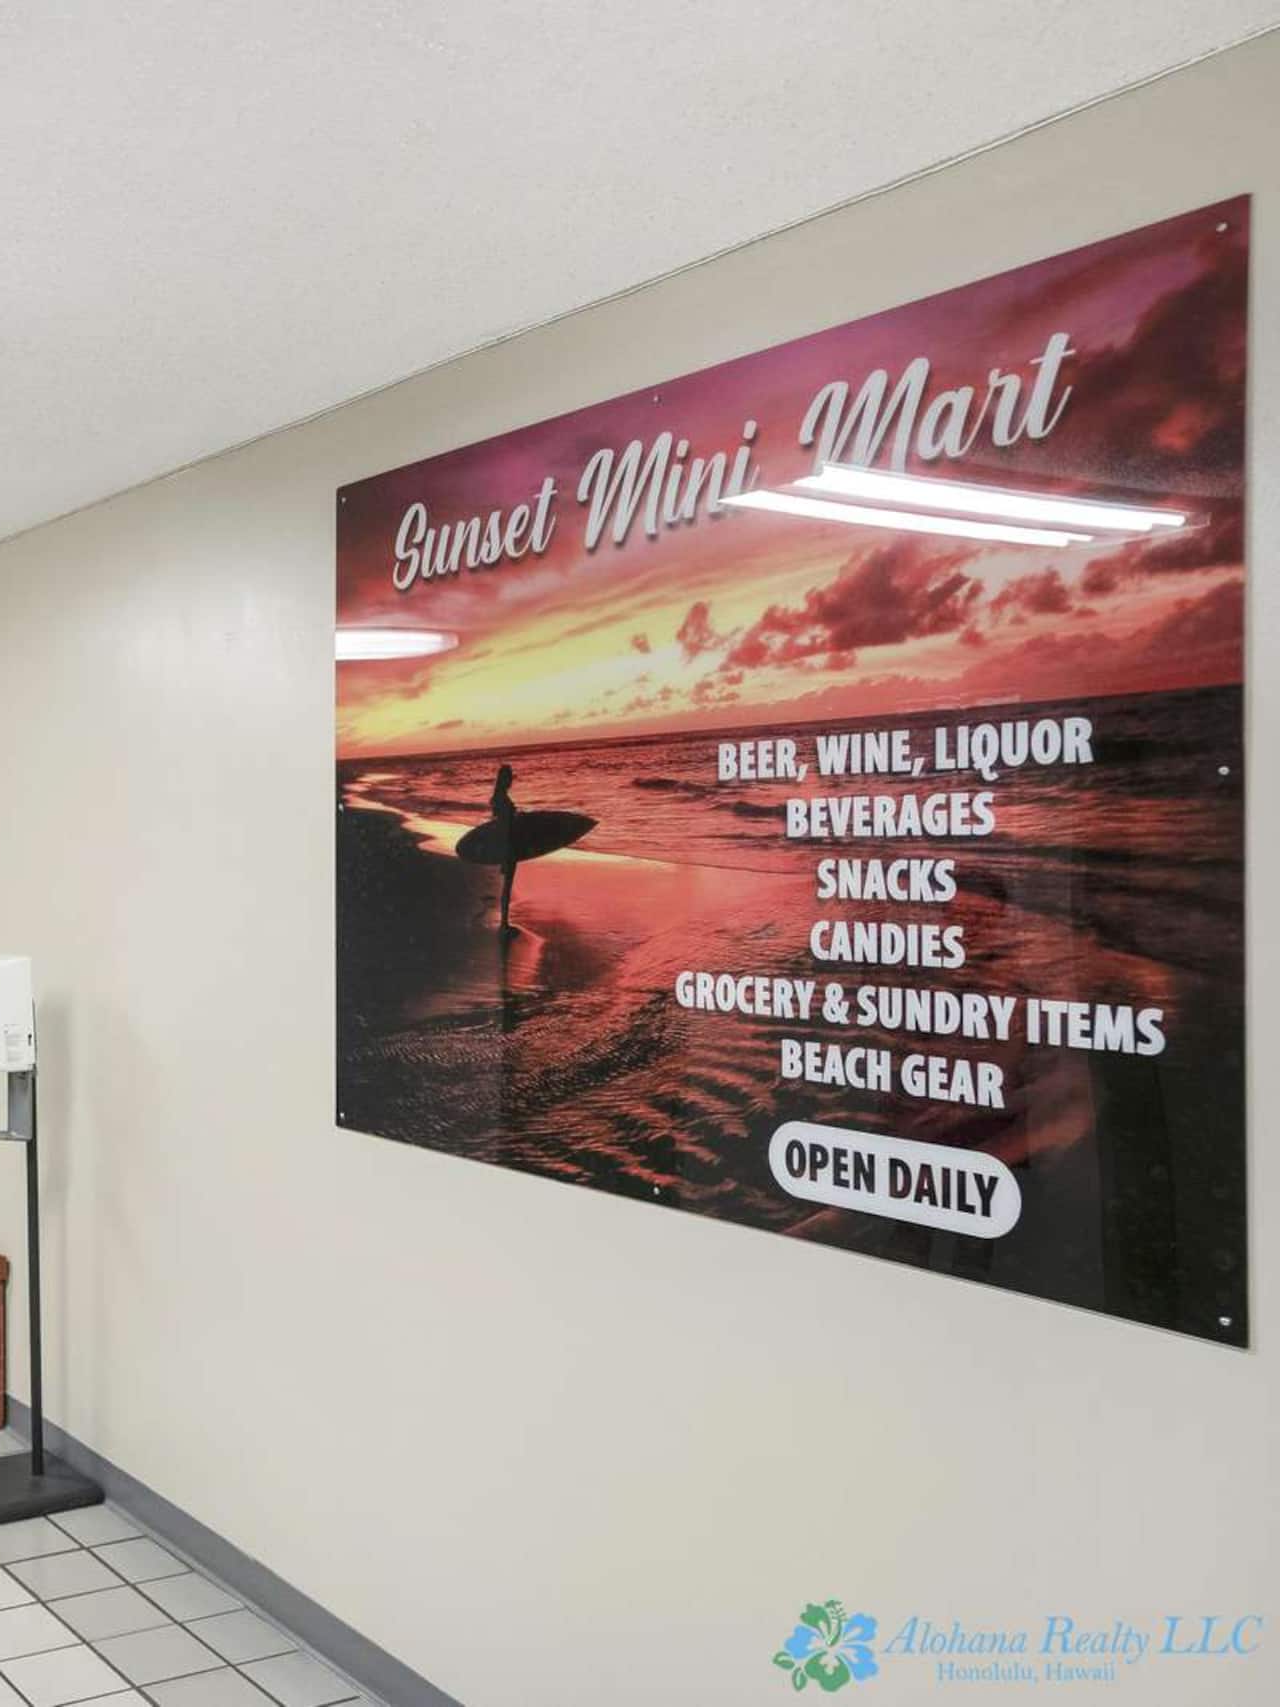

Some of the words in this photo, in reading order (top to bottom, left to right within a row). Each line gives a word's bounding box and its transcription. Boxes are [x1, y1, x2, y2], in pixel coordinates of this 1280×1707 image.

[393, 477, 558, 592] Sunset
[577, 420, 760, 549] Mini
[799, 332, 1076, 476] Mart
[718, 739, 808, 782] BEER,
[816, 730, 925, 777] WINE,
[934, 717, 1094, 782] LIQUOR
[786, 792, 997, 839] BEVERAGES
[817, 859, 958, 903] SNACKS
[810, 921, 966, 969] CANDIES
[675, 971, 815, 1020] GROCERY
[823, 983, 850, 1024] &
[857, 985, 1017, 1041] SUNDRY
[1026, 998, 1167, 1058] ITEMS
[780, 1039, 891, 1093] BEACH
[901, 1054, 1006, 1109] GEAR
[785, 1139, 876, 1195] OPEN
[888, 1157, 999, 1218] DAILY
